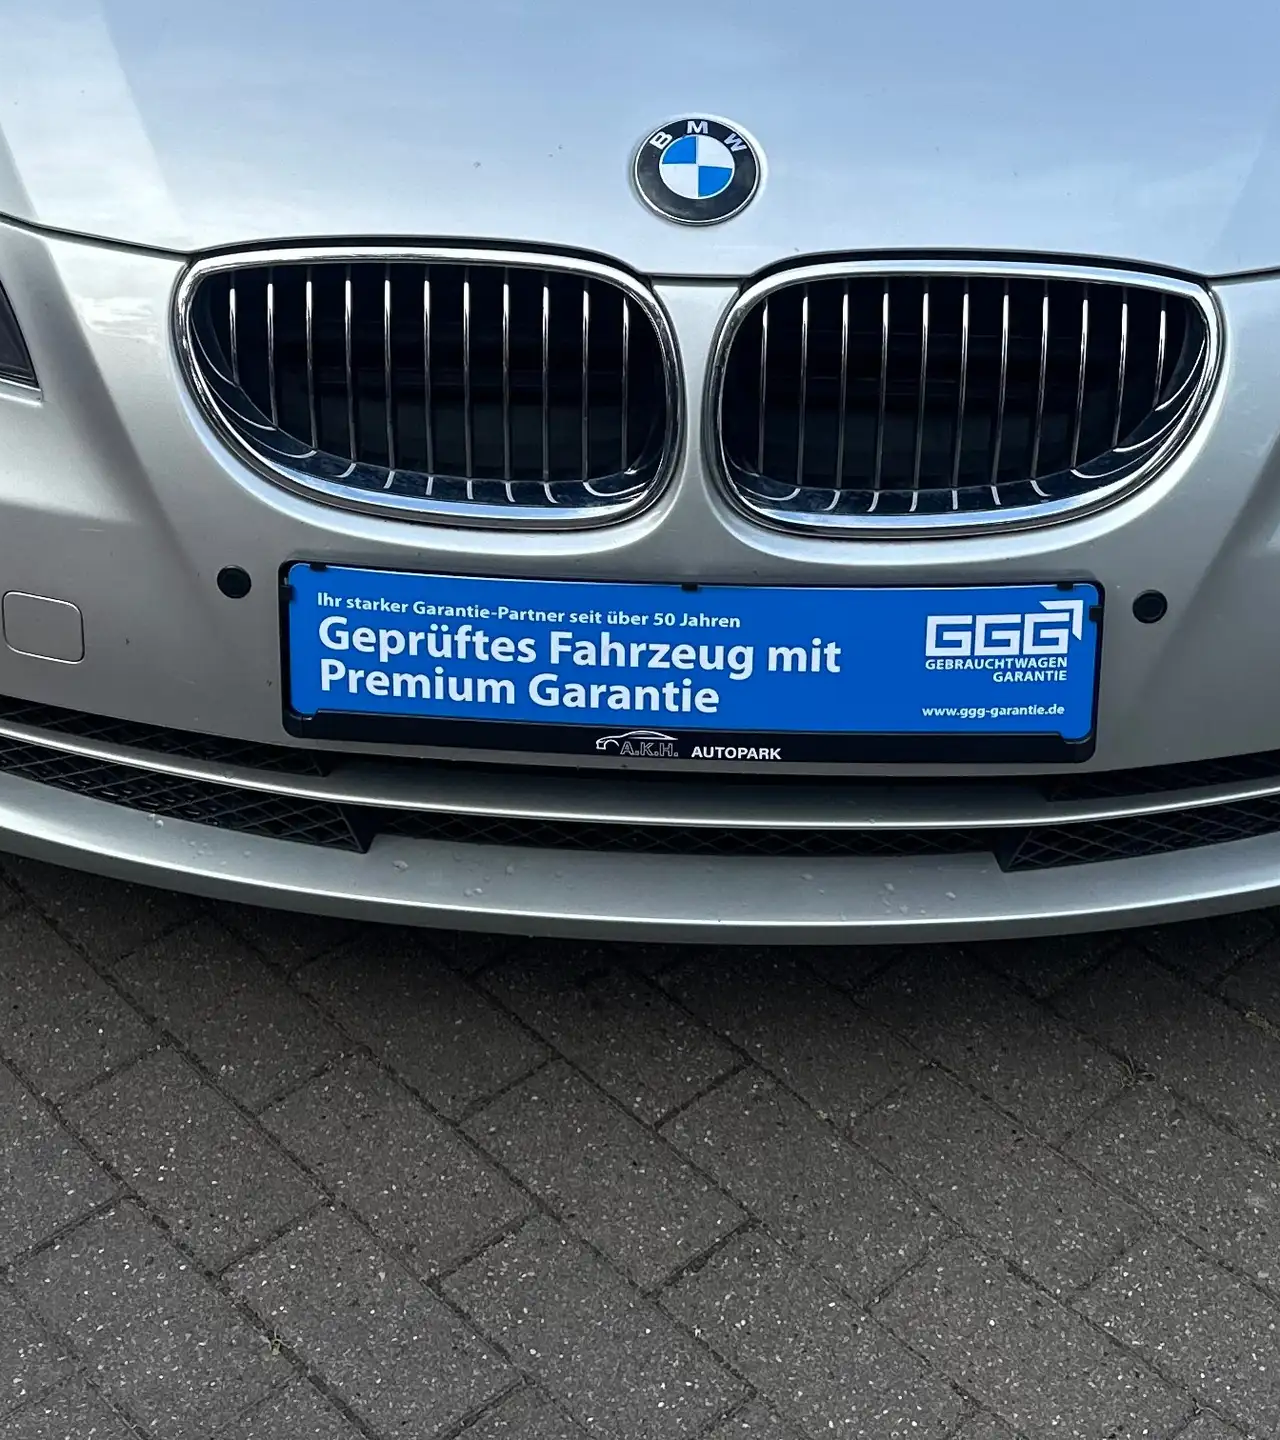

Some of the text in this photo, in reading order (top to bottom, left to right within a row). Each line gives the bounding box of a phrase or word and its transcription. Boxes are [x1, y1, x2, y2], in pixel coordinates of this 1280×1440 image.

[649, 120, 748, 152] BMW
[317, 592, 741, 629] Ihr starker Garantie-Partner seit über 50 Jahren
[318, 615, 842, 681] Geprüftes Fahrzeug mit
[925, 612, 1070, 657] GGG
[925, 656, 1068, 670] GEBRAUCHTWAGEN
[992, 670, 1068, 683] GARANTIE
[320, 658, 720, 714] Premium Garantie
[922, 703, 1066, 719] www.ggg-garantie.de
[620, 741, 782, 760] A.K.H. AUTOPARK
